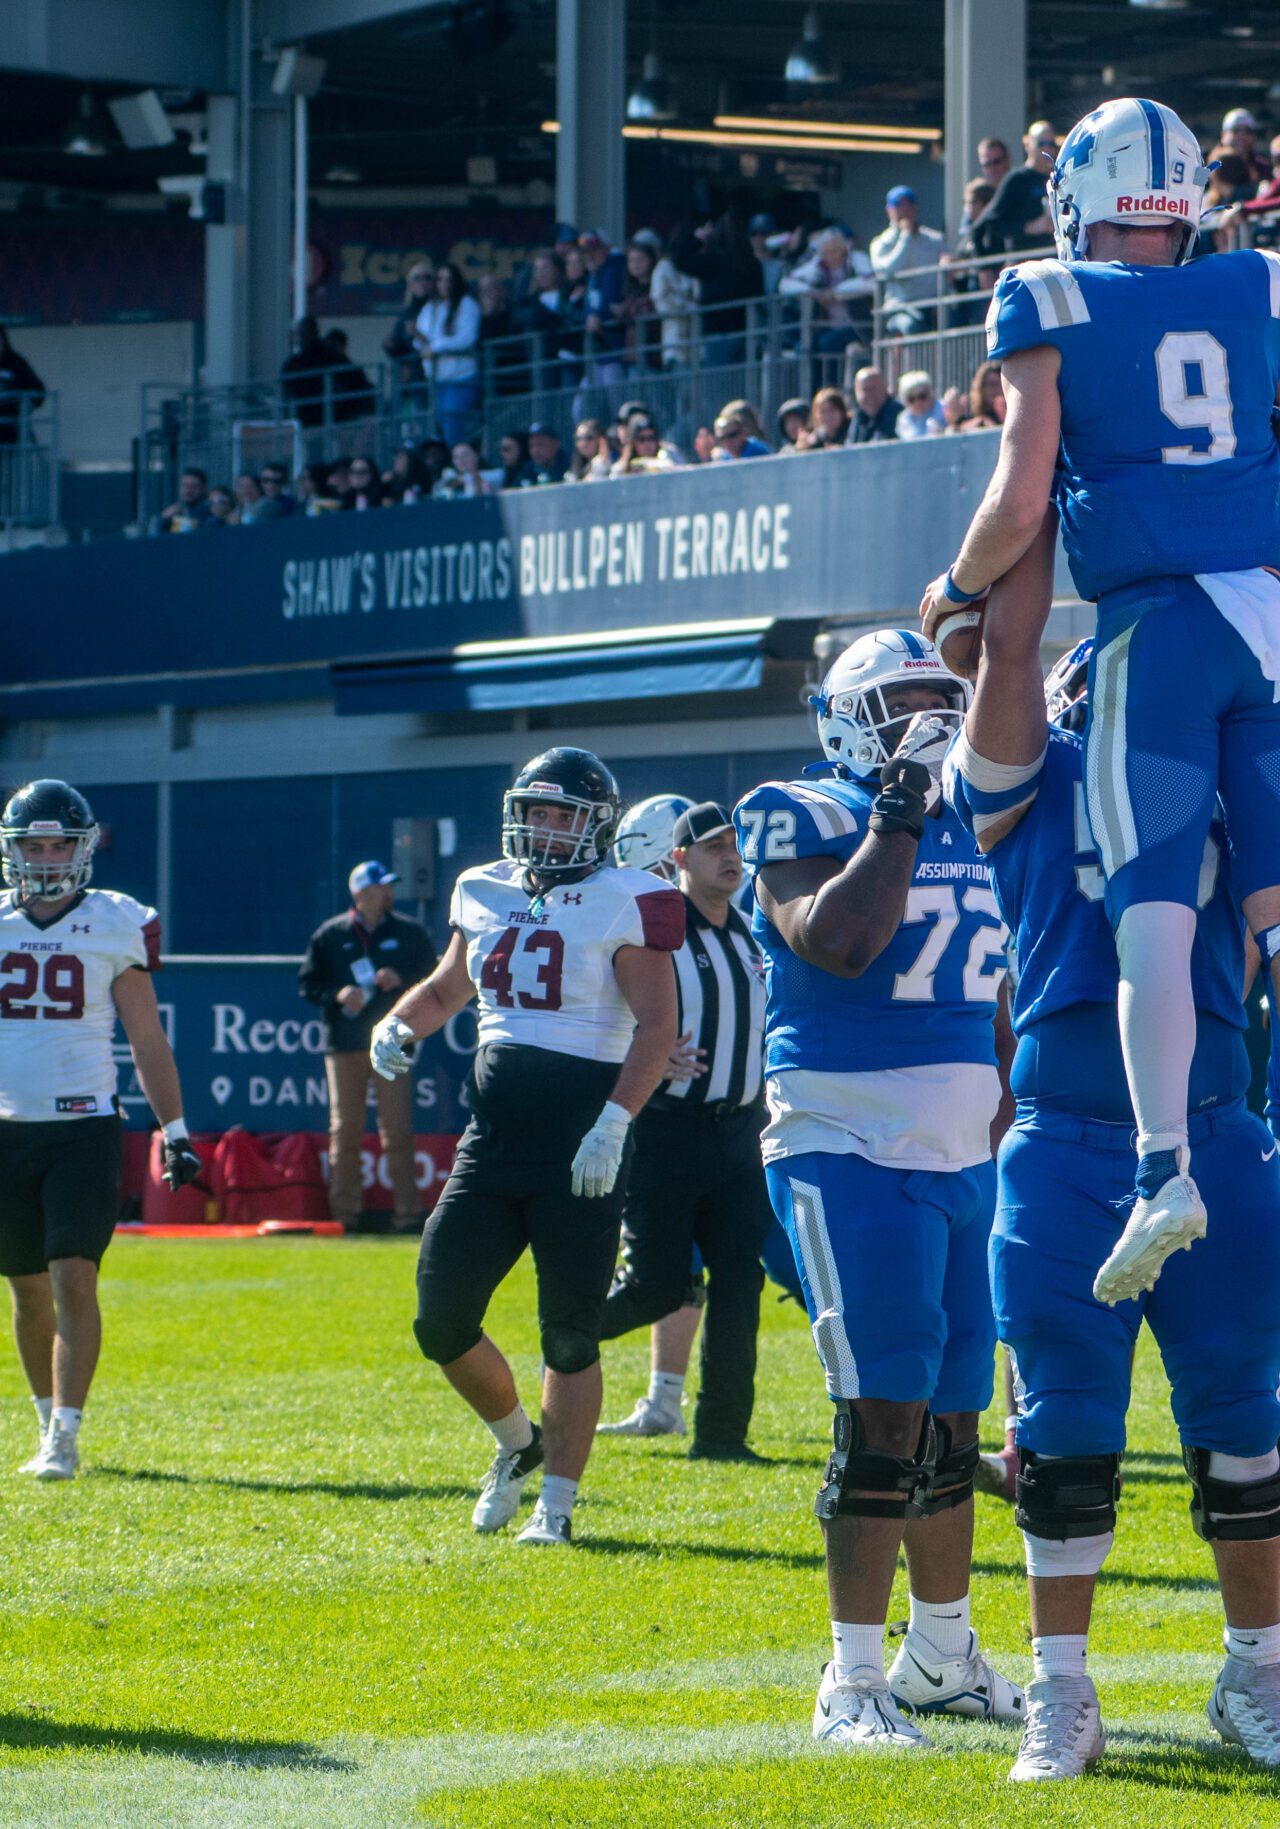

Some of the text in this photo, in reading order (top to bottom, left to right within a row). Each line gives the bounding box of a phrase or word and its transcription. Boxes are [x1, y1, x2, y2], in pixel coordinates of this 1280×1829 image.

[1171, 161, 1185, 184] 9
[1117, 196, 1189, 217] Riddell
[1154, 331, 1237, 465] 9
[283, 504, 791, 619] SHAW'S VISITORS BULLPEN TERRACE
[740, 809, 798, 861] 72
[915, 862, 990, 880] ASSUMPTION
[508, 910, 550, 925] PIERCE
[891, 884, 1009, 1002] 72
[20, 942, 63, 951] PIERCE
[480, 927, 565, 1011] 43
[0, 952, 85, 1019] 29
